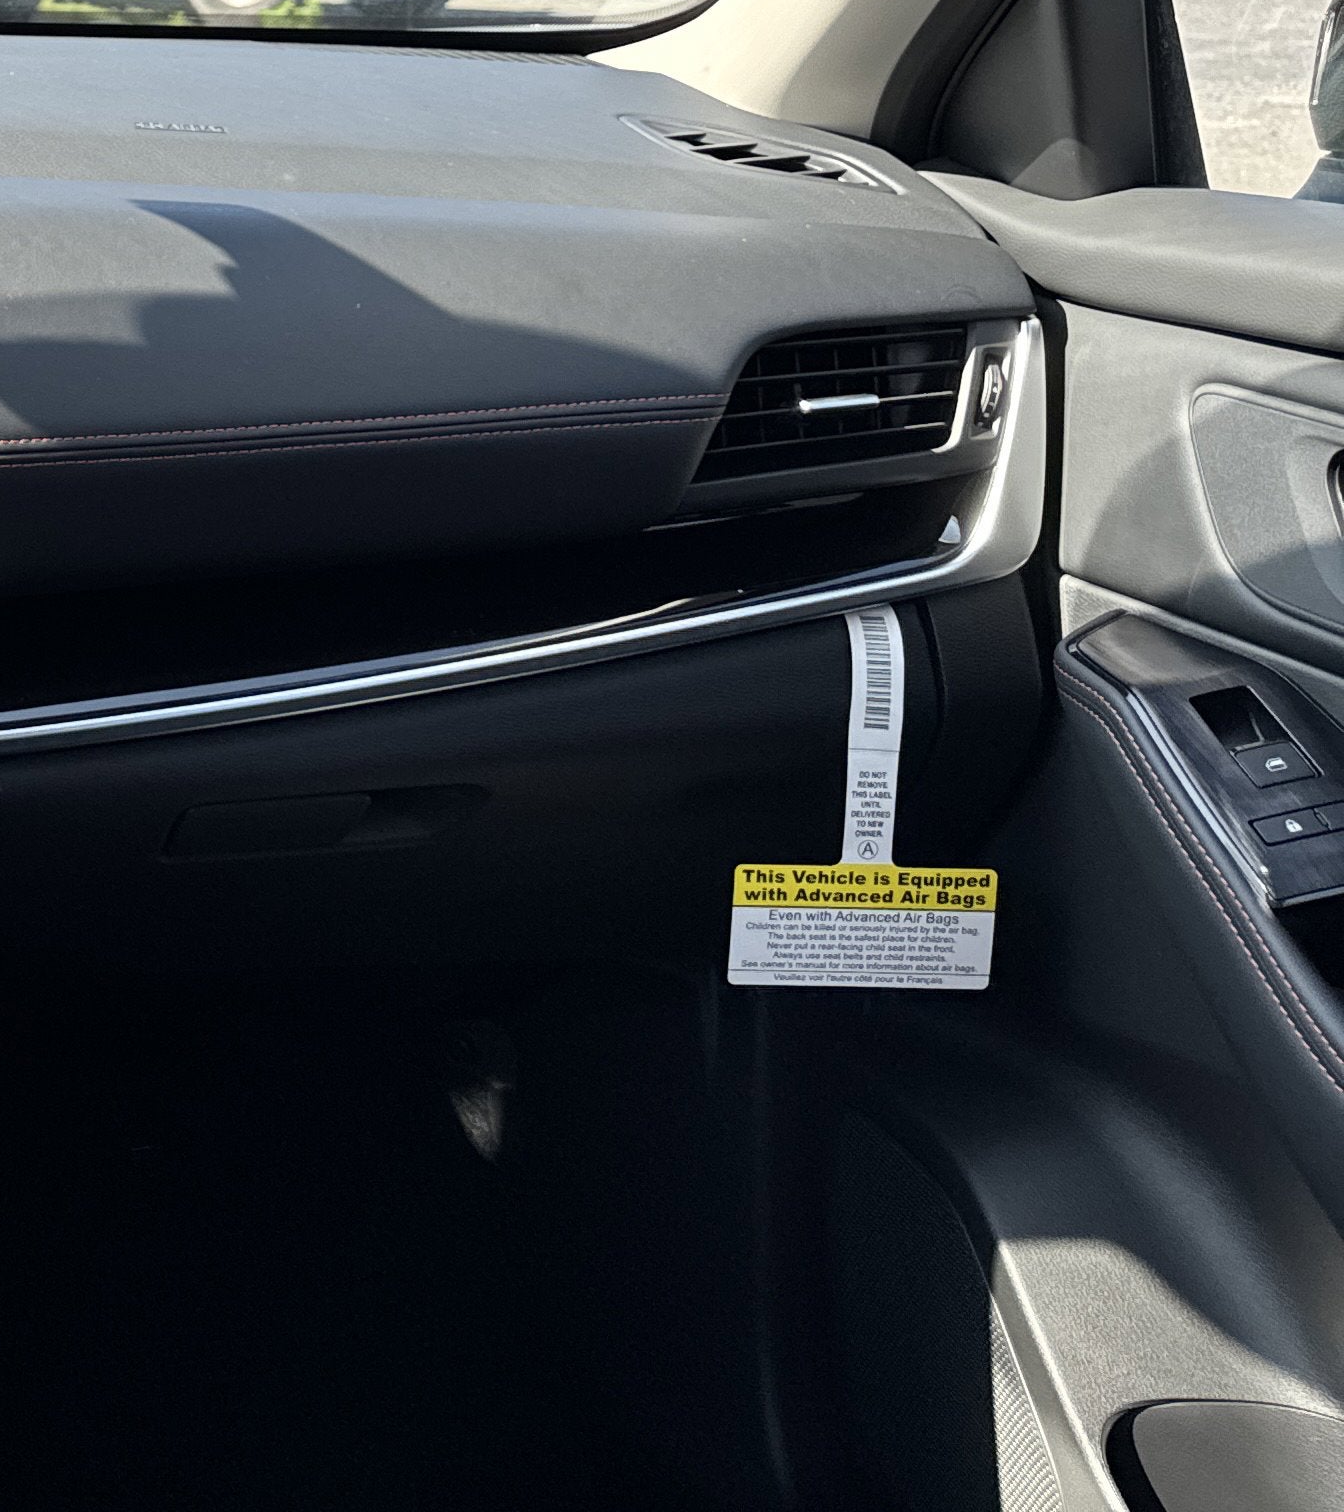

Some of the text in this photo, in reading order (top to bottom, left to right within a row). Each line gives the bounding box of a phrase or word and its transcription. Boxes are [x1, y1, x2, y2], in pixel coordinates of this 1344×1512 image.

[859, 771, 887, 779] DO NOT
[857, 781, 888, 789] REMOVE
[851, 790, 892, 799] THIS LABEL
[850, 810, 891, 818] DELIVERED
[867, 820, 884, 828] NEW
[742, 869, 991, 890] This Vehicle is Equipped
[744, 887, 986, 908] with Advanced Air Bags
[768, 909, 960, 926] Even with Advanced Air Bags
